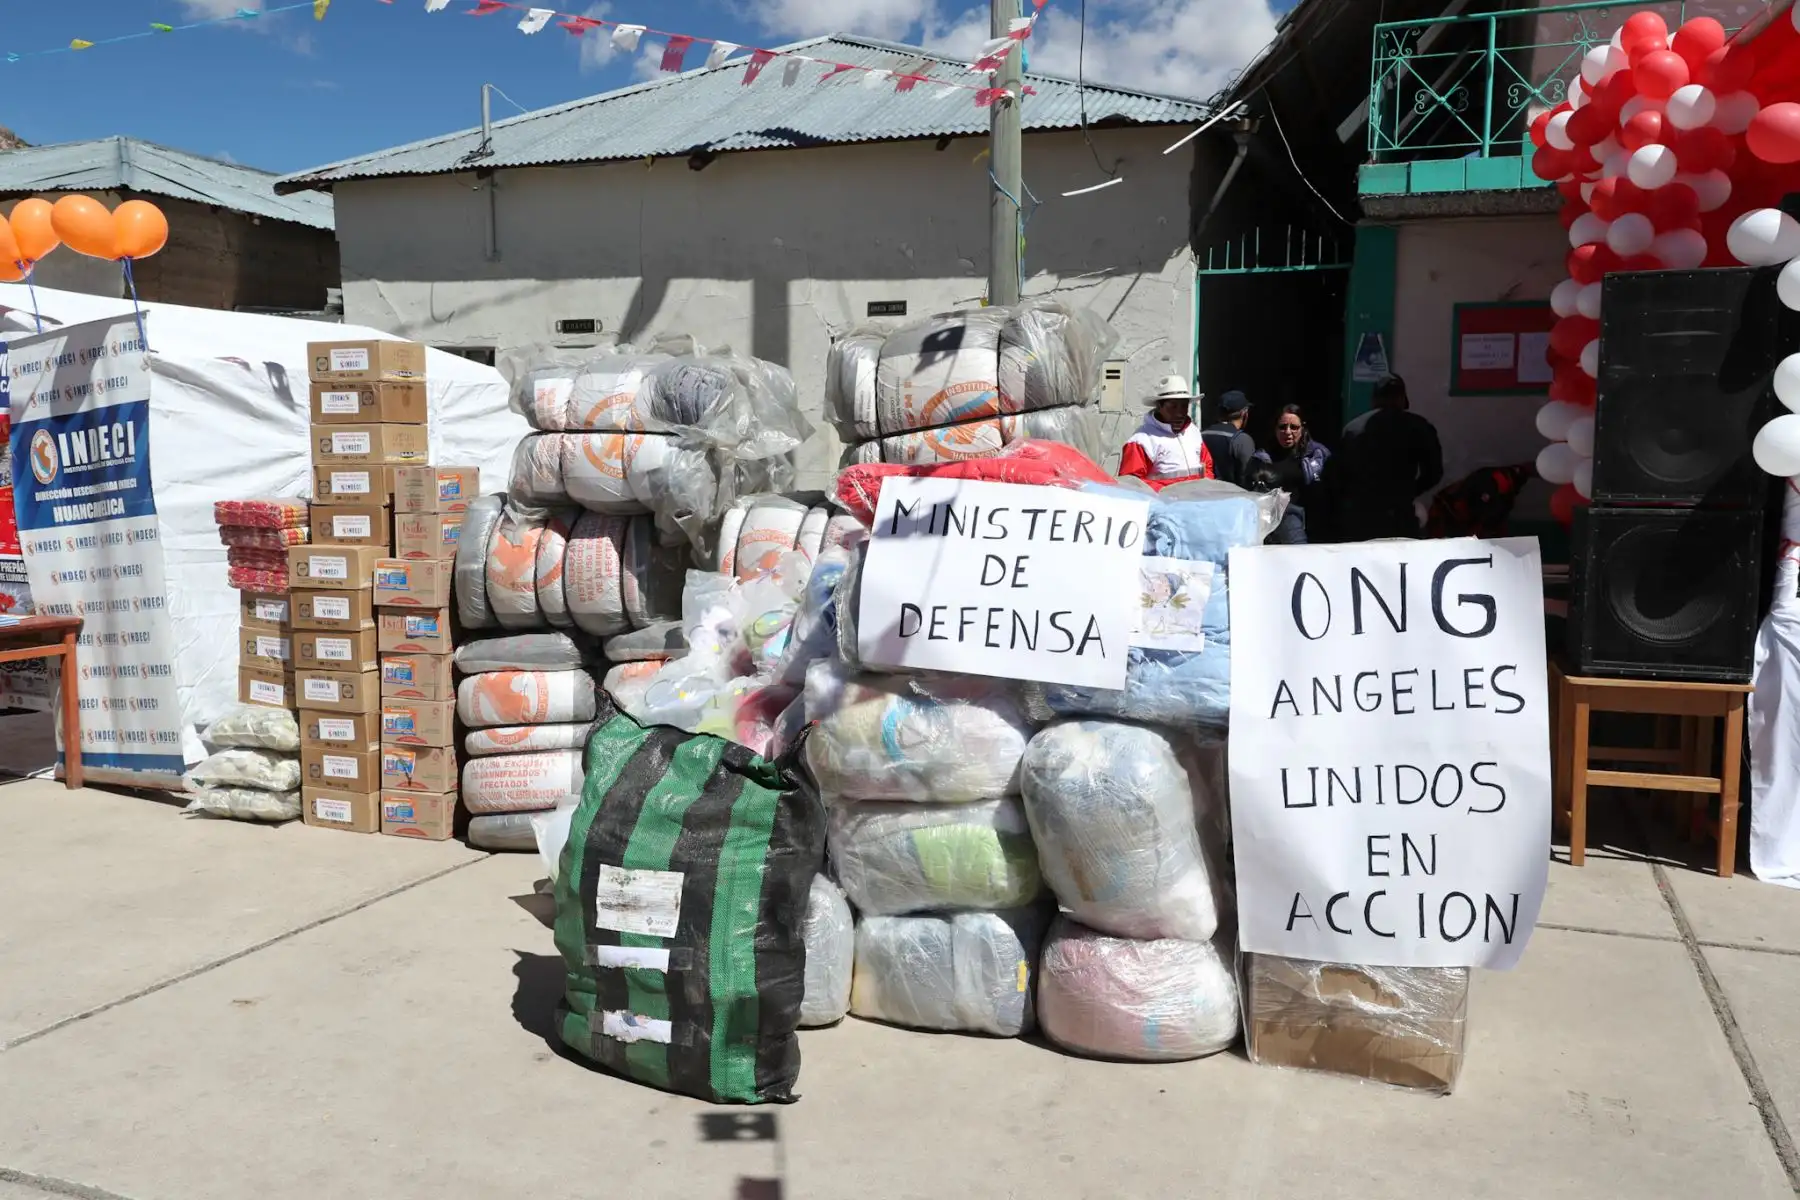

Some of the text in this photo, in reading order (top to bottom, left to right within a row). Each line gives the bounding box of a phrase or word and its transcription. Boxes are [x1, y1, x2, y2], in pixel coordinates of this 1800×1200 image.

[20, 360, 41, 375] INDECI
[52, 351, 76, 367] INDECI
[38, 389, 60, 403] INDECI
[58, 420, 136, 467] INDECI
[35, 540, 61, 552] INDECI
[133, 528, 157, 541] INDECI
[891, 497, 1140, 549] MINISTERIO
[59, 569, 87, 582] INDECI
[119, 564, 143, 577] INDECI
[980, 554, 1030, 588] DE
[47, 603, 72, 614] INDECI
[140, 596, 164, 609] INDECI
[1291, 554, 1498, 640] ONG
[127, 631, 150, 642] INDECI
[898, 602, 1106, 659] DEFENSA
[148, 664, 172, 676] INDECI
[136, 698, 159, 709] INDECI
[1268, 664, 1526, 719] ANGELES
[1280, 762, 1507, 814] UNIDOS
[1367, 833, 1438, 877] EN
[1285, 890, 1523, 945] ACCION
